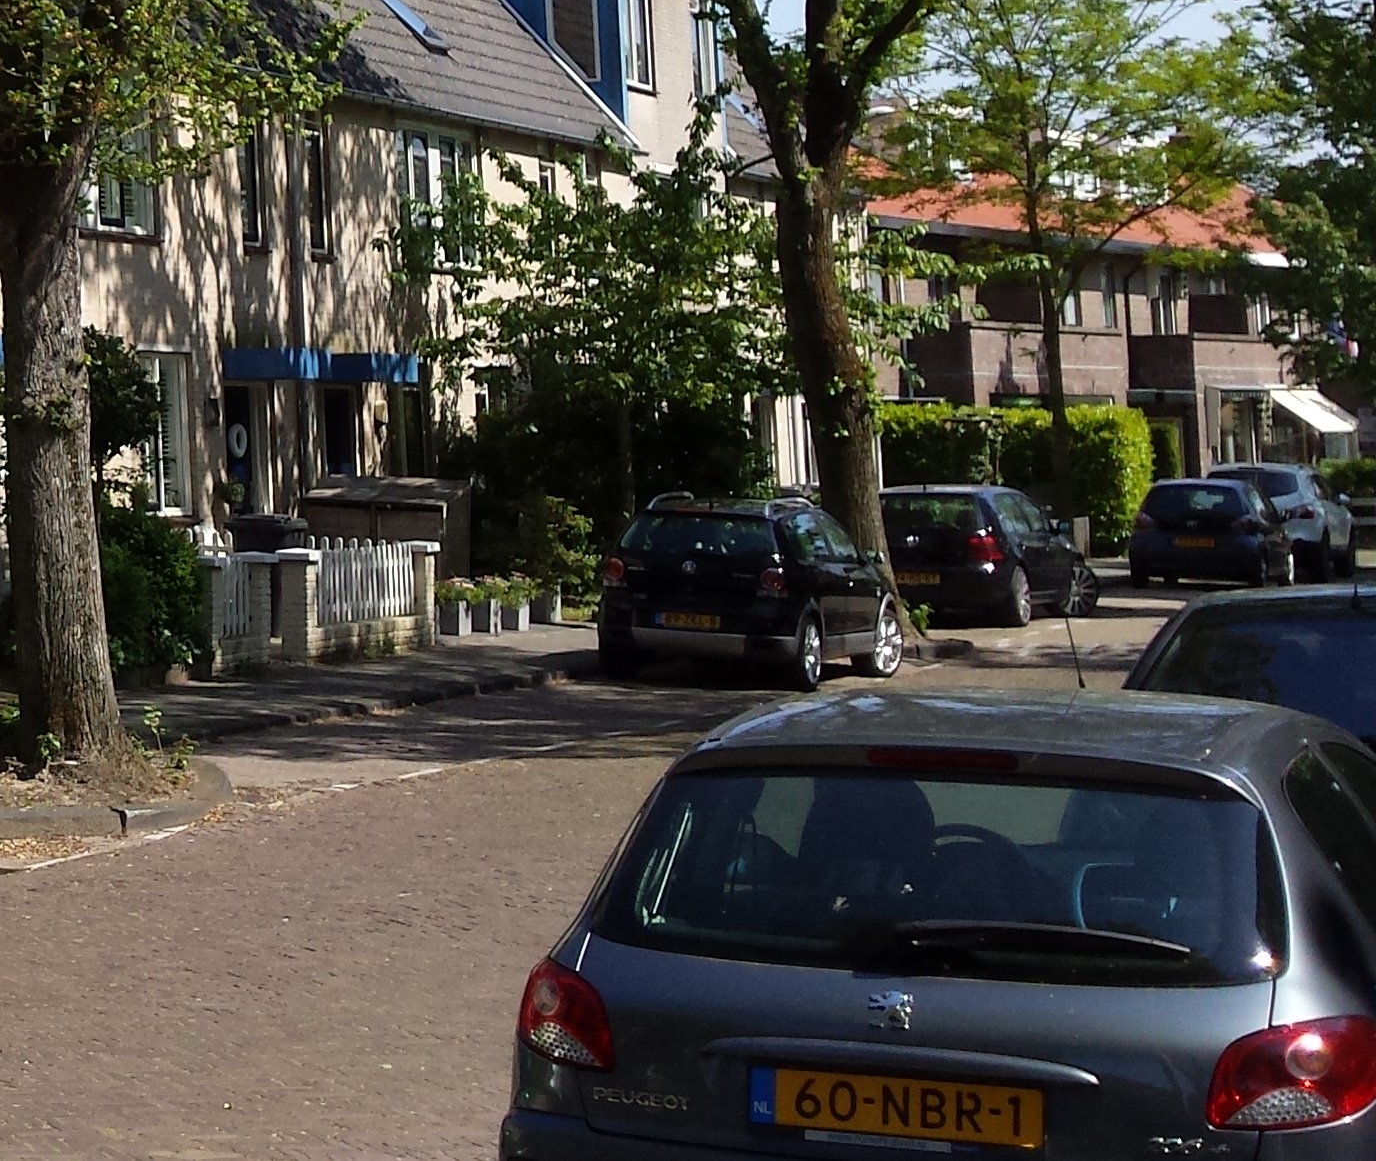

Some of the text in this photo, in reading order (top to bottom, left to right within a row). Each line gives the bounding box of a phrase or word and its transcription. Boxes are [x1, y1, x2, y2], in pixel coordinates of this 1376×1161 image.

[593, 1086, 690, 1111] PEUGEOT
[754, 1101, 772, 1114] NL
[794, 1078, 1022, 1137] 60-NBR-1
